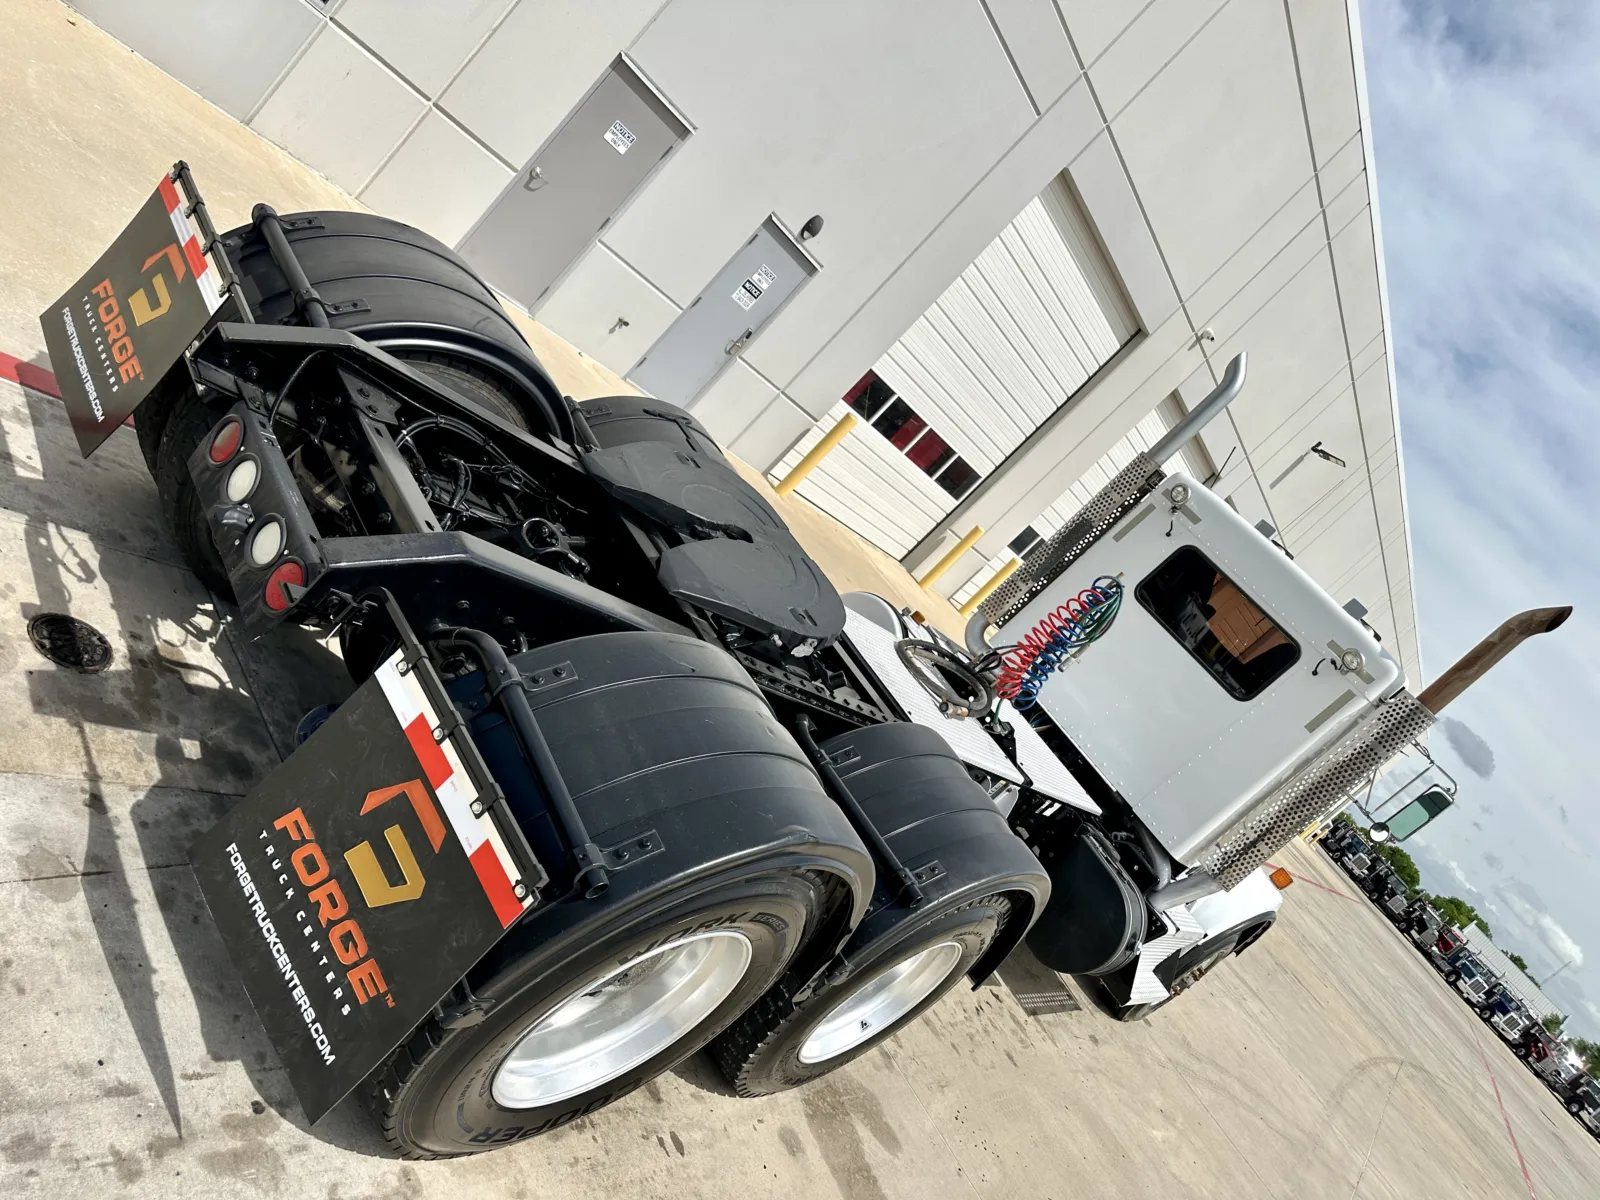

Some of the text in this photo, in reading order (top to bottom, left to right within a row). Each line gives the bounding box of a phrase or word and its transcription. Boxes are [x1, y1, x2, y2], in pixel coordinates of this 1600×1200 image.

[609, 128, 630, 149] EMPLOYEES
[610, 137, 621, 148] ONLY
[613, 122, 635, 143] NOTICE
[744, 281, 761, 298] NOTICE
[760, 265, 775, 281] NOTICE
[82, 295, 119, 393] TRUCK CENTERS
[91, 278, 143, 385] FORGE
[61, 306, 106, 423] FORGETRUCKCENTERS.COM
[258, 829, 351, 1016] TRUCK CENTERS
[273, 807, 388, 1005] FORGE
[752, 913, 788, 931] SERIES
[225, 842, 336, 1066] FORGETRUCKCENTERS.COM
